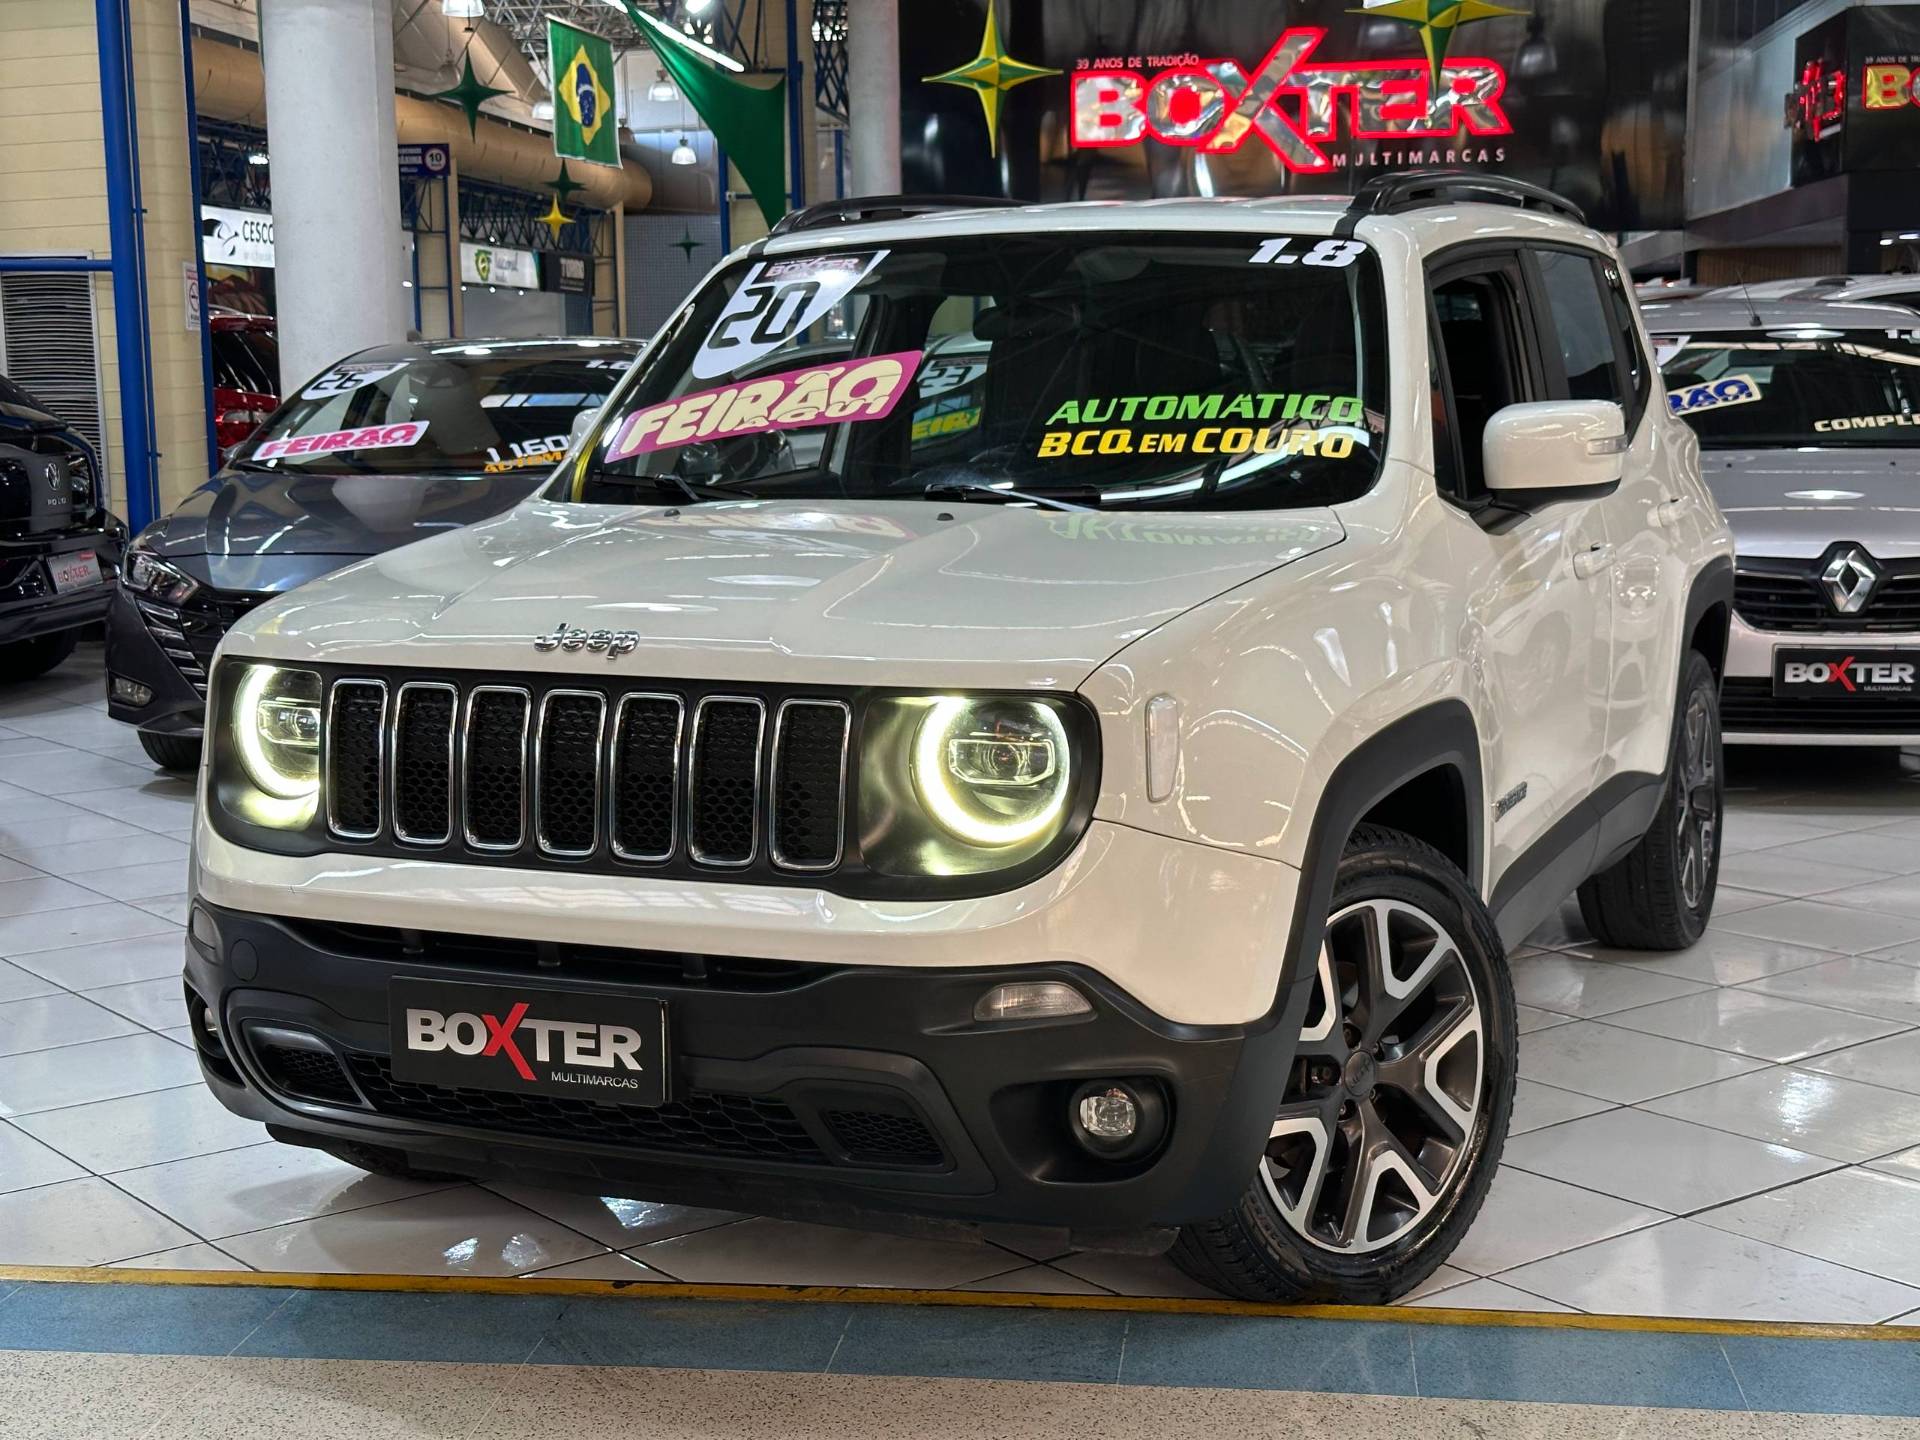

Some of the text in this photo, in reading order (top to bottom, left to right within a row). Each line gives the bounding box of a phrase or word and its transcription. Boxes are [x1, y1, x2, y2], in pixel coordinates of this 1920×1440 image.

[1076, 53, 1199, 70] 39 ANOS DE TRADIÇÃO
[1071, 27, 1514, 174] BOXTER
[429, 152, 442, 162] 10
[1332, 148, 1506, 169] MULTIMARCAS
[1248, 238, 1367, 268] 1.8
[707, 281, 820, 350] 20
[585, 359, 633, 370] 1.6
[920, 366, 973, 388] 23
[311, 372, 364, 390] 26
[620, 360, 903, 454] FEIRÃO
[1045, 394, 1363, 426] AUTOMÁTICO
[261, 424, 419, 458] FEIRÃO
[1138, 432, 1186, 454] EM
[1191, 427, 1354, 459] COURO
[484, 451, 566, 473] AUTOM
[47, 497, 67, 506] POLO
[534, 622, 640, 661] Jeep
[1784, 656, 1915, 692] BOXTER
[406, 1003, 643, 1081] BOXTER
[551, 1071, 639, 1090] MULTIMARCAS
